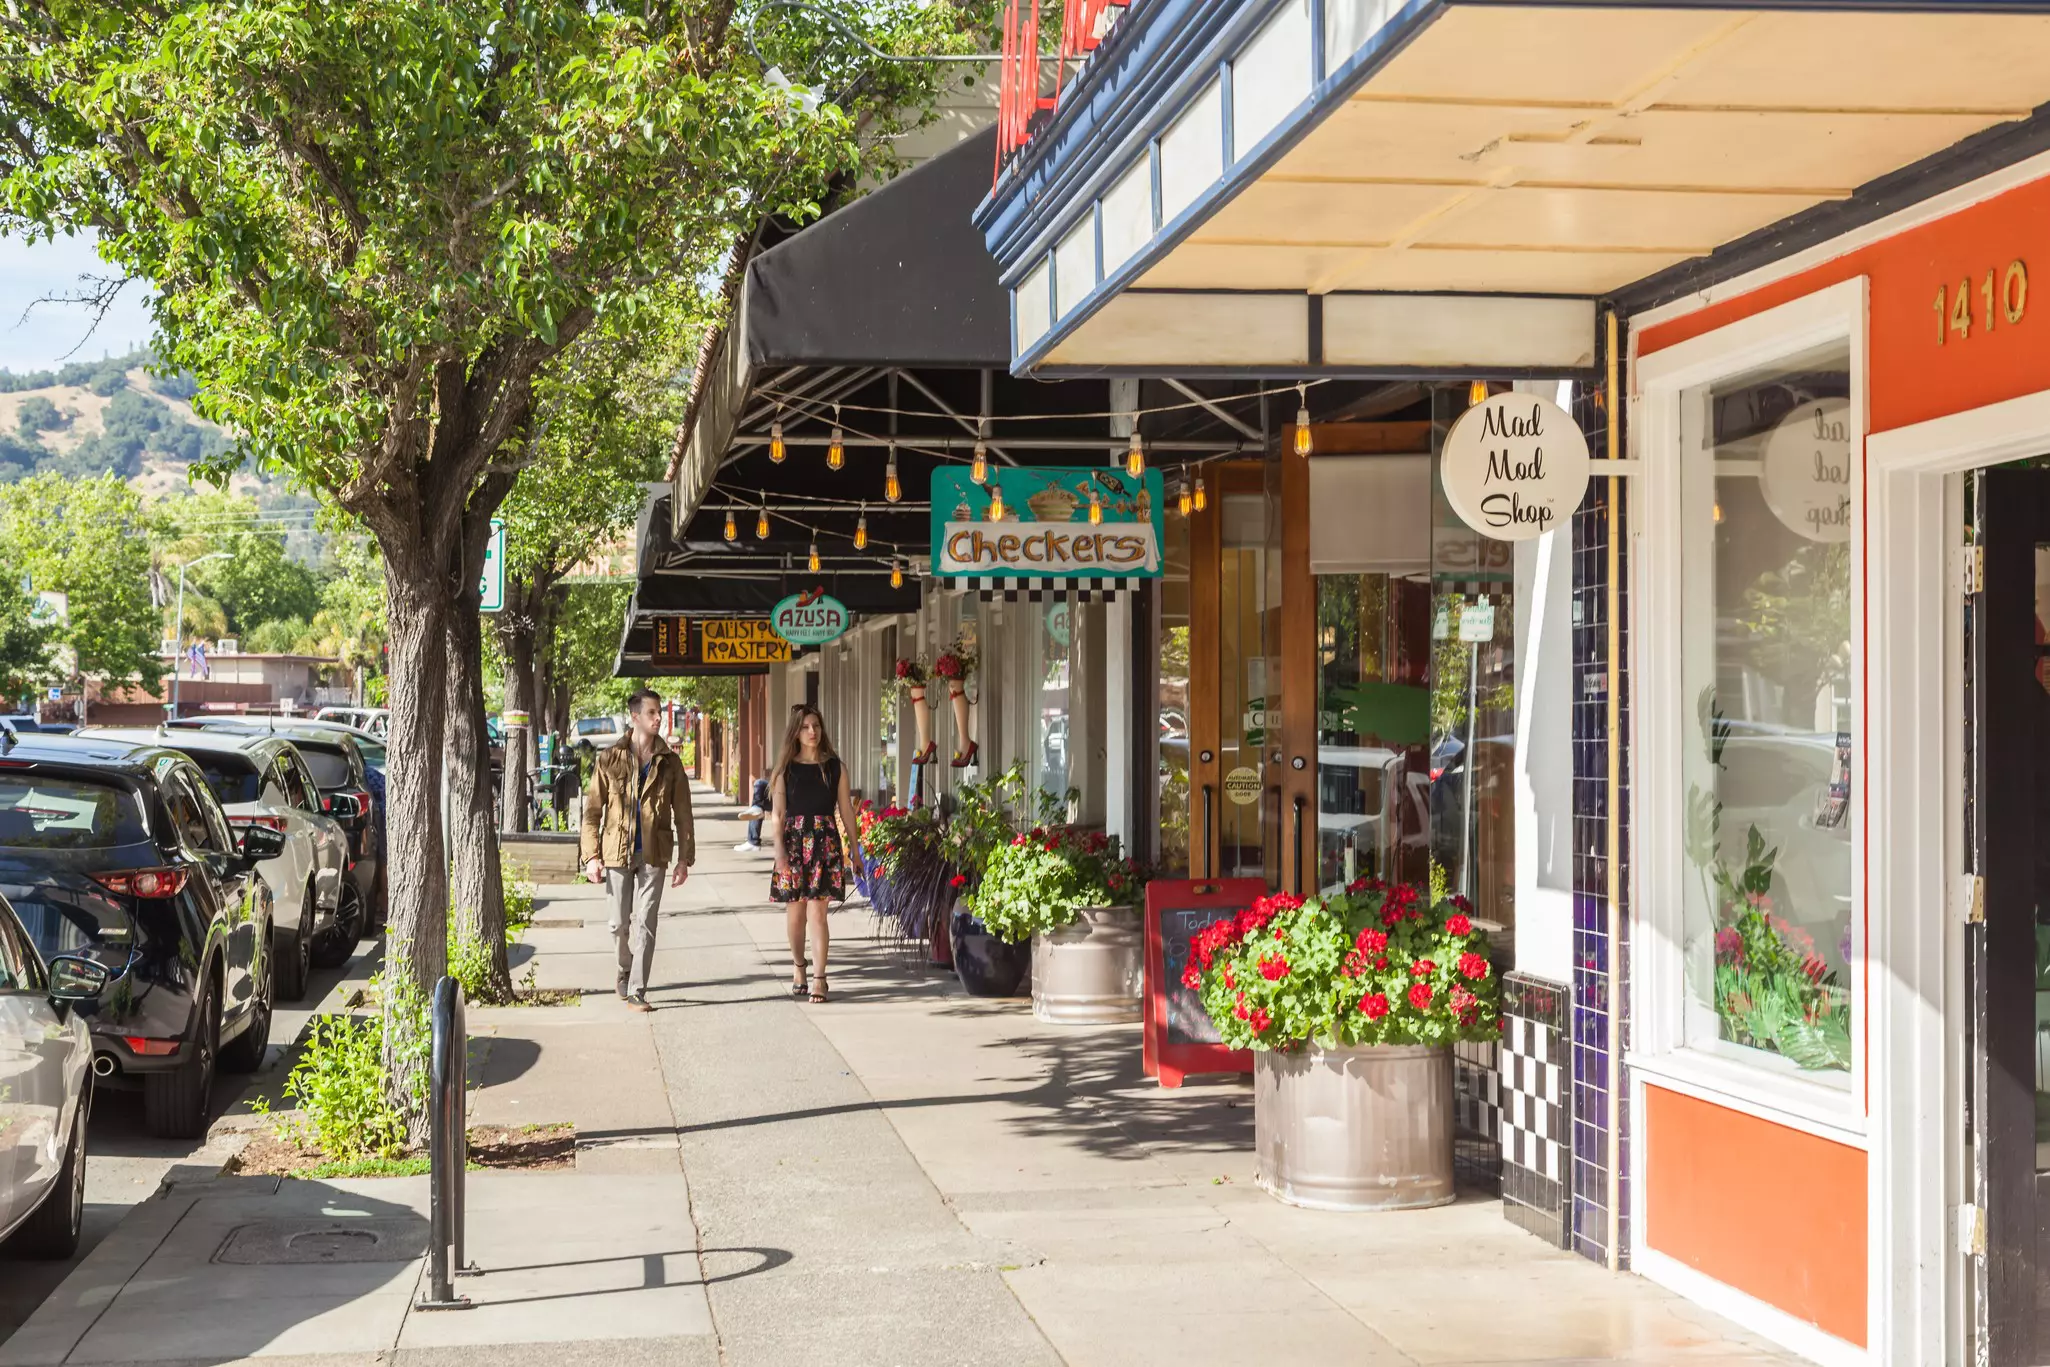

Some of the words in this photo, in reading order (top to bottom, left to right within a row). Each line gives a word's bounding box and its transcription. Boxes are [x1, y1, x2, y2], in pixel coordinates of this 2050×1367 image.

[1933, 259, 2028, 346] 1410
[1480, 403, 1544, 443] Mad
[1484, 446, 1546, 486] Mod
[1480, 492, 1554, 532] Shop
[948, 529, 1146, 563] Checkers
[705, 621, 781, 639] CALISTOG
[779, 609, 840, 627] AZUSA
[707, 642, 789, 659] ROASTERY
